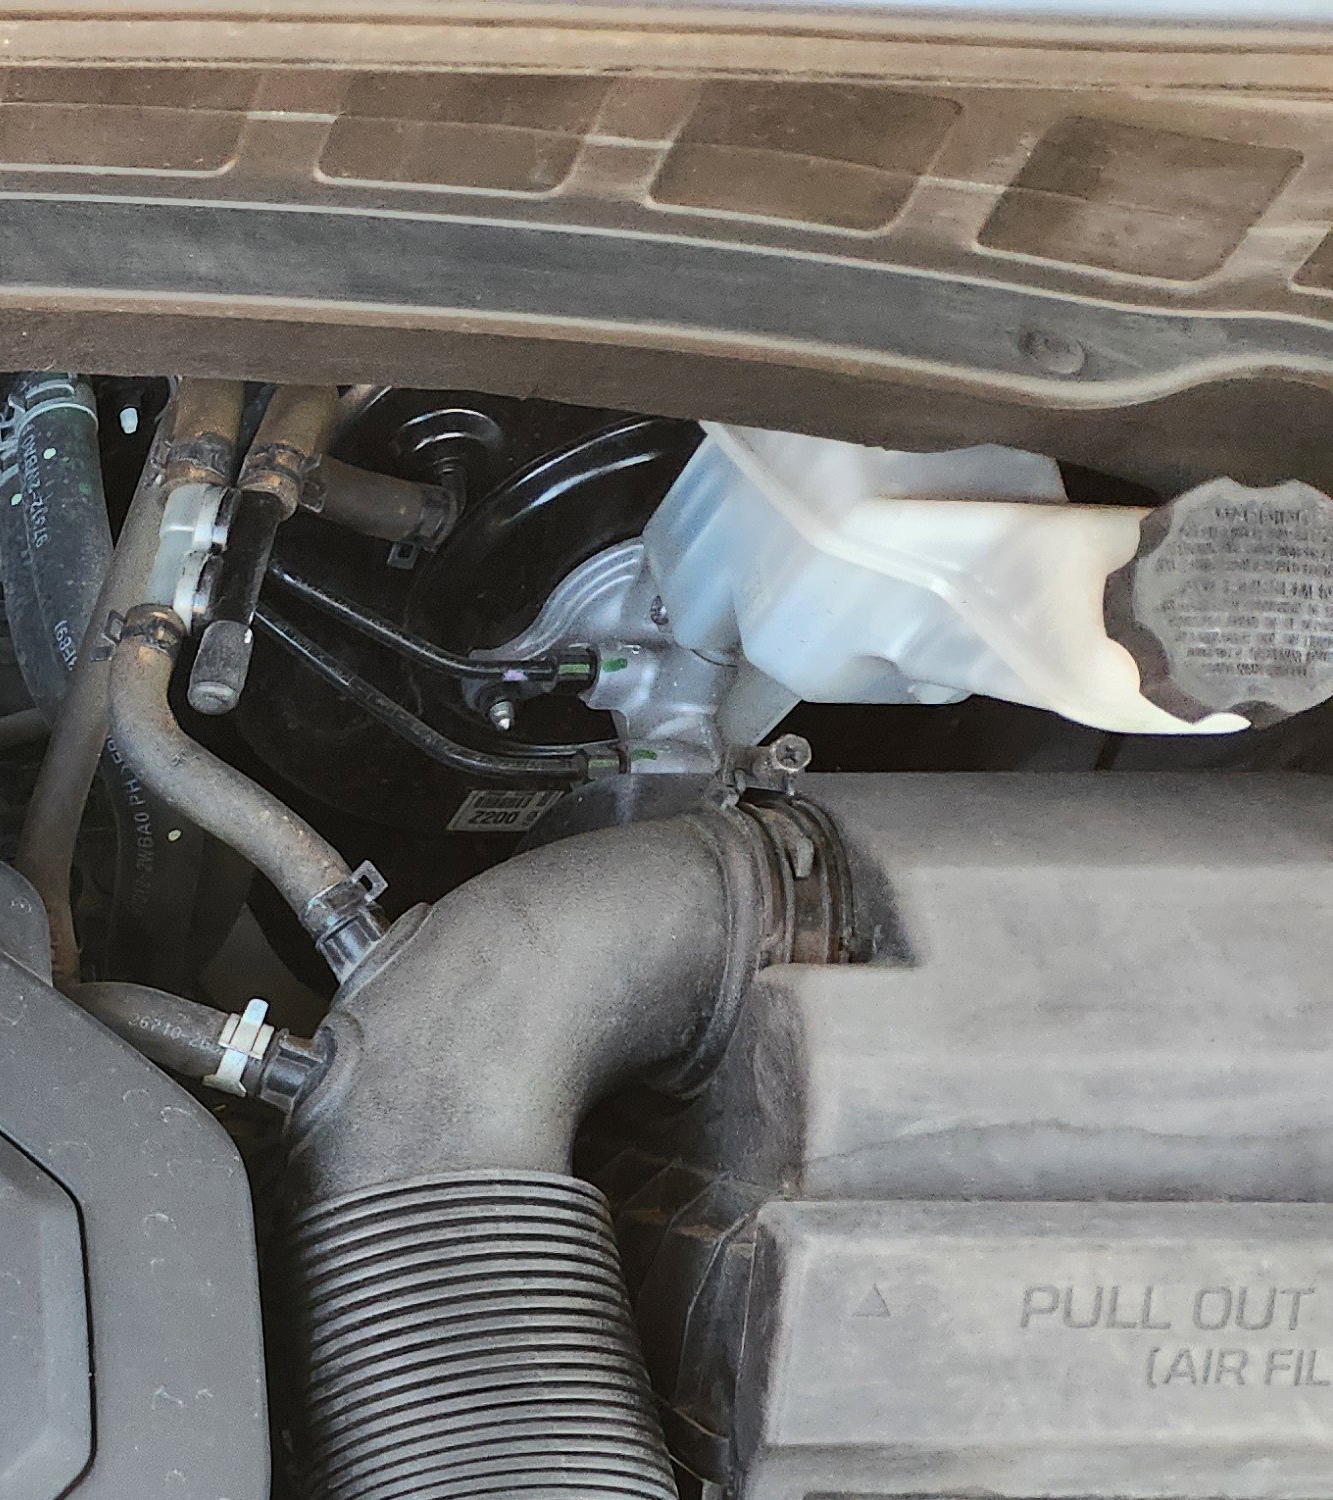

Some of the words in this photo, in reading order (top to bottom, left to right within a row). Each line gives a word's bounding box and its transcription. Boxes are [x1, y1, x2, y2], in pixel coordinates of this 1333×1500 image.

[468, 810, 521, 825] Z200
[1020, 1285, 1171, 1330] PULL
[1191, 1285, 1317, 1332] OUT
[1145, 1346, 1246, 1389] (AIR
